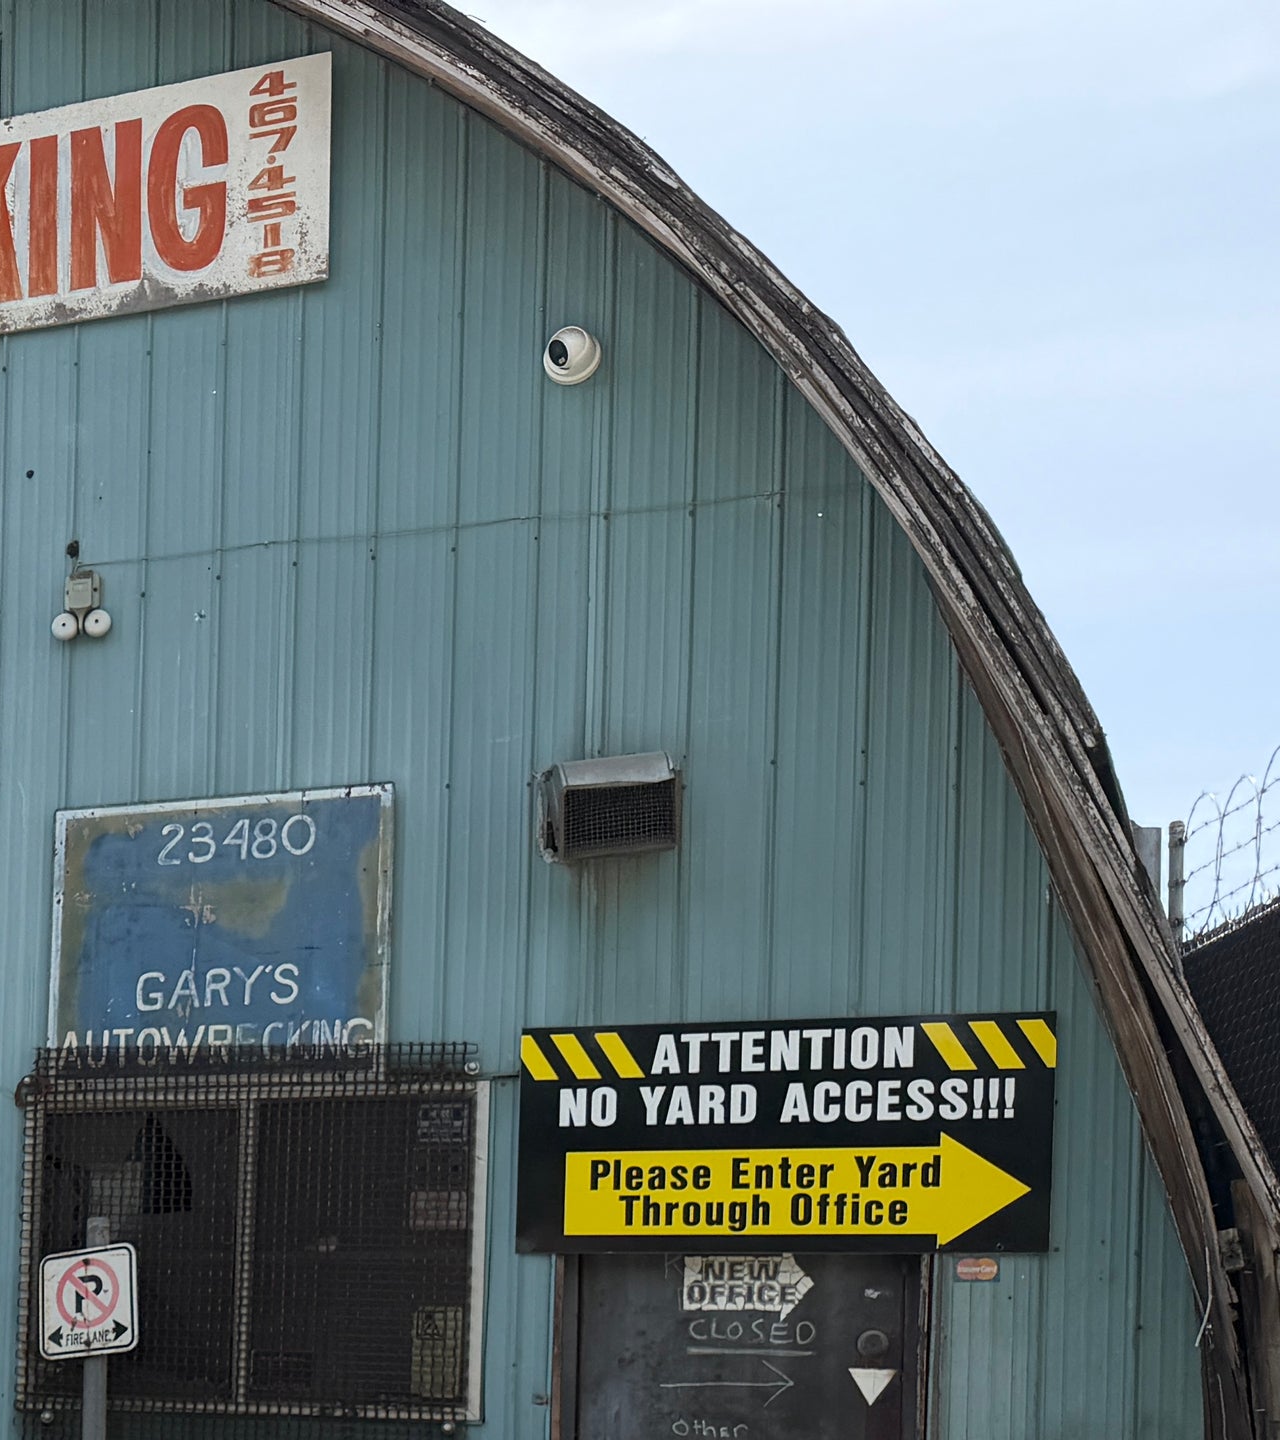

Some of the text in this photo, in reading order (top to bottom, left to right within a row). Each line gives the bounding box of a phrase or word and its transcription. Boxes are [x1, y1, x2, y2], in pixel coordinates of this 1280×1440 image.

[156, 814, 317, 867] 23480
[135, 963, 300, 1012] GARY'S
[650, 1026, 915, 1076] ATTENTION
[558, 1077, 1016, 1128] NO YARD ACCESS!!!
[589, 1154, 942, 1191] Please Enter Yard
[619, 1193, 909, 1232] Through Office
[703, 1260, 779, 1282] NEW
[687, 1280, 798, 1305] OFFICE
[65, 1331, 85, 1347] FIRE
[689, 1319, 816, 1345] CLOSED
